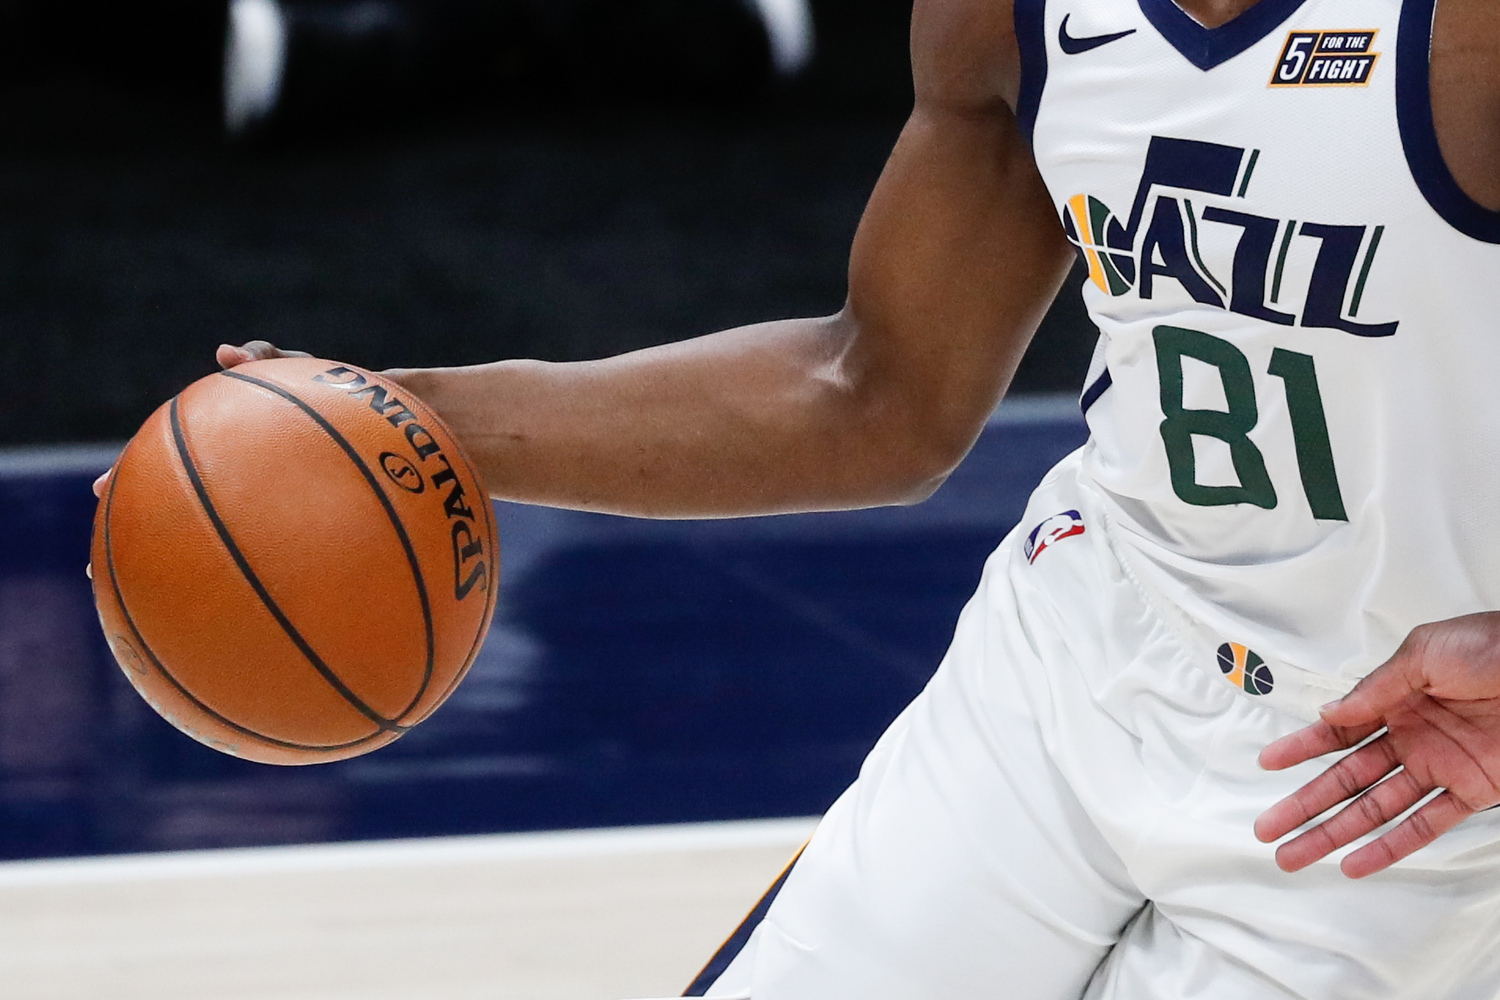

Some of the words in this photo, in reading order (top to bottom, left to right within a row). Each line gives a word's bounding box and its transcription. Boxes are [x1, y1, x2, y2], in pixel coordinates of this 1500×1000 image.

[1279, 36, 1313, 81] 5
[1308, 59, 1370, 80] FIGHT
[1321, 36, 1345, 49] FOR
[1345, 36, 1368, 49] THE
[1063, 135, 1400, 338] JAZZ
[311, 366, 488, 601] SPALDING
[1151, 323, 1349, 523] 81
